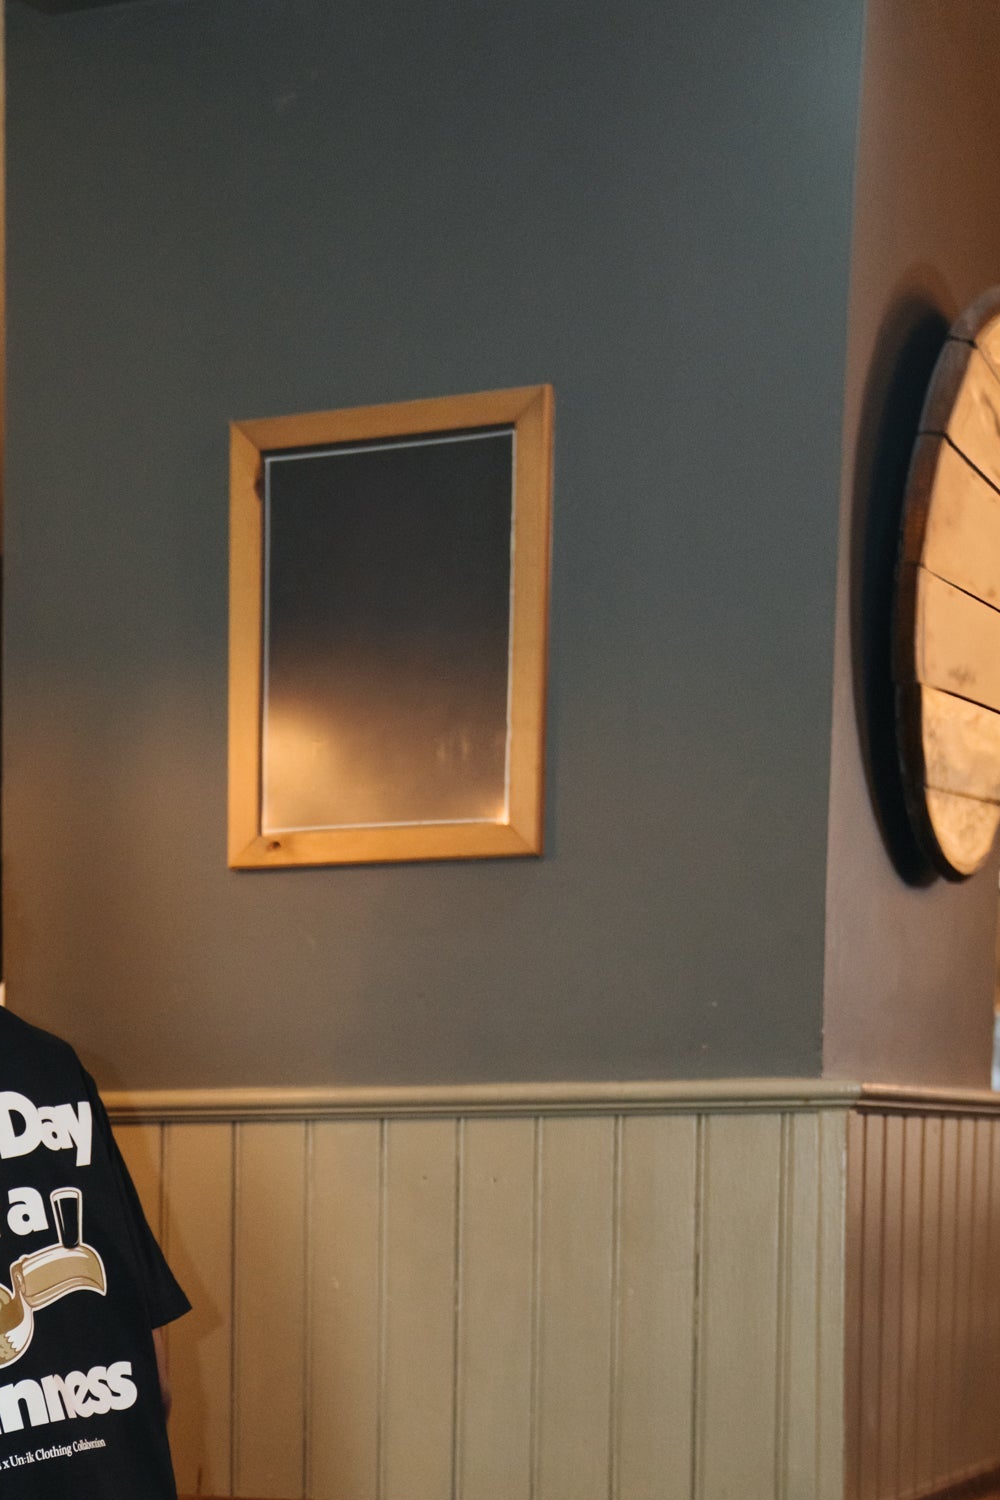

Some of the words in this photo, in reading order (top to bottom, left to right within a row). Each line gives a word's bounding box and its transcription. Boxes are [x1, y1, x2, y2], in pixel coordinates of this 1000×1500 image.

[7, 1186, 49, 1236] a
[3, 1459, 11, 1469] x
[35, 1442, 72, 1461] Clothing
